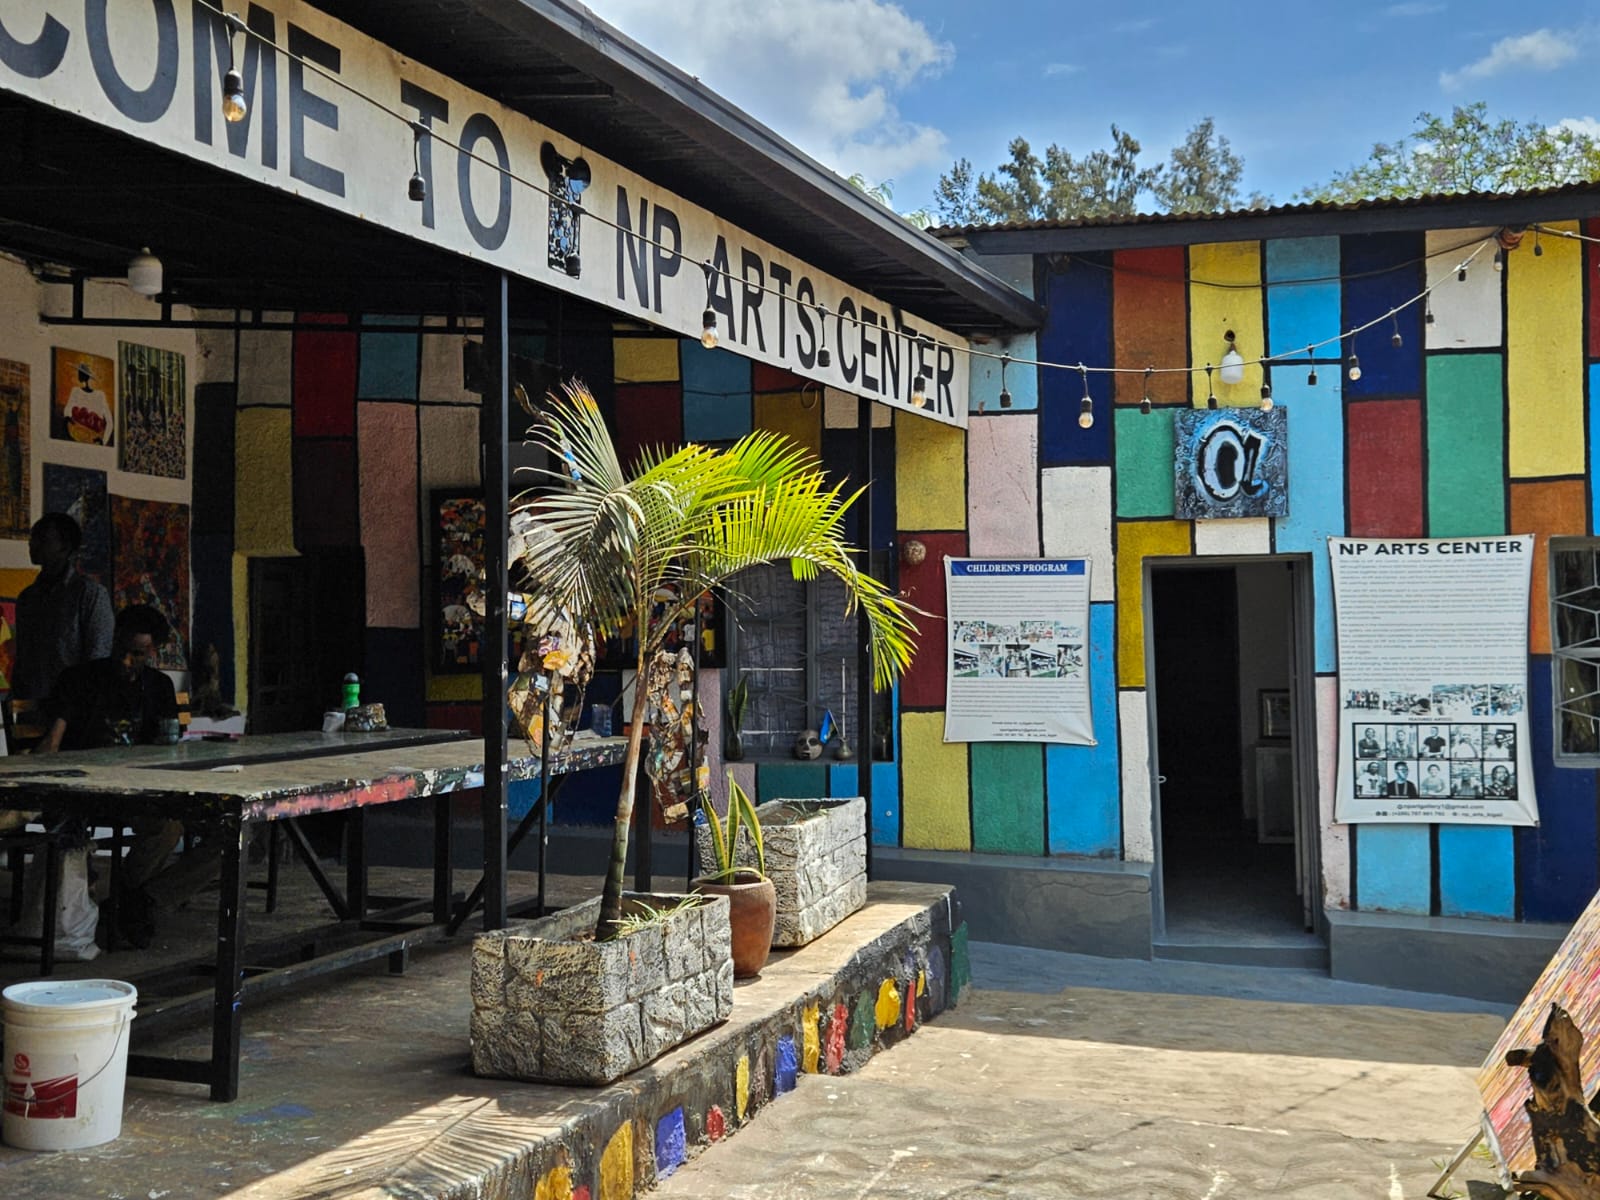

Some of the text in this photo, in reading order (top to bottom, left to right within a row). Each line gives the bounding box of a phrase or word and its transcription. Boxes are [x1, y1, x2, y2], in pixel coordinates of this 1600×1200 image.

[401, 78, 511, 251] TO
[616, 184, 683, 314] NP
[711, 235, 817, 370] ARTS
[836, 296, 955, 418] CENTER
[1339, 540, 1523, 556] NP ARTS CENTER
[966, 563, 1068, 573] CHILDREN'S PROGRAM
